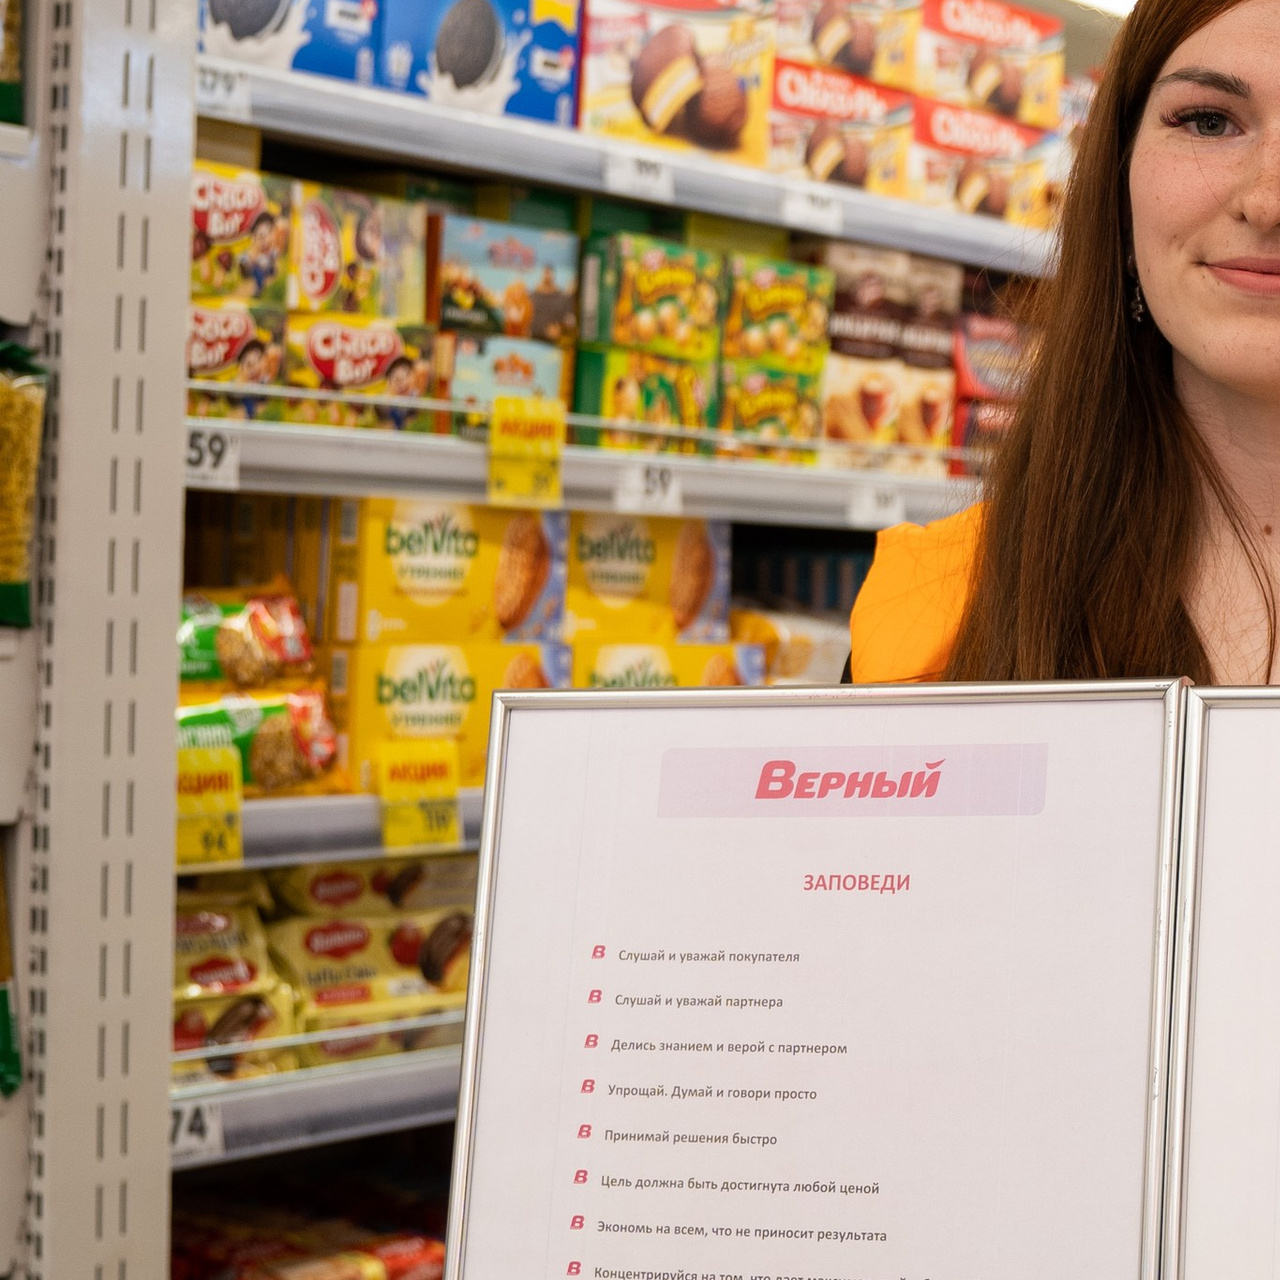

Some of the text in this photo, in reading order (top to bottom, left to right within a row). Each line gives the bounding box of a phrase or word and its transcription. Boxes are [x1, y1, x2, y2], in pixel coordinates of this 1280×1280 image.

[377, 657, 477, 706] belVita
[803, 874, 911, 895] ЗАПОВЕДИ
[618, 949, 800, 965] Слушай и уважай покупателя
[614, 994, 784, 1010] Слушай и уважай партнера
[610, 1039, 848, 1057] Делись знанием и верой с партнером
[608, 1084, 818, 1102] Упрощай. Думай и говори просто
[604, 1129, 778, 1148] Принимай решения быстро
[601, 1175, 880, 1196] Цель должна быть достигнута любой ценой
[597, 1220, 887, 1243] Экономь на всем, что не приносит результата
